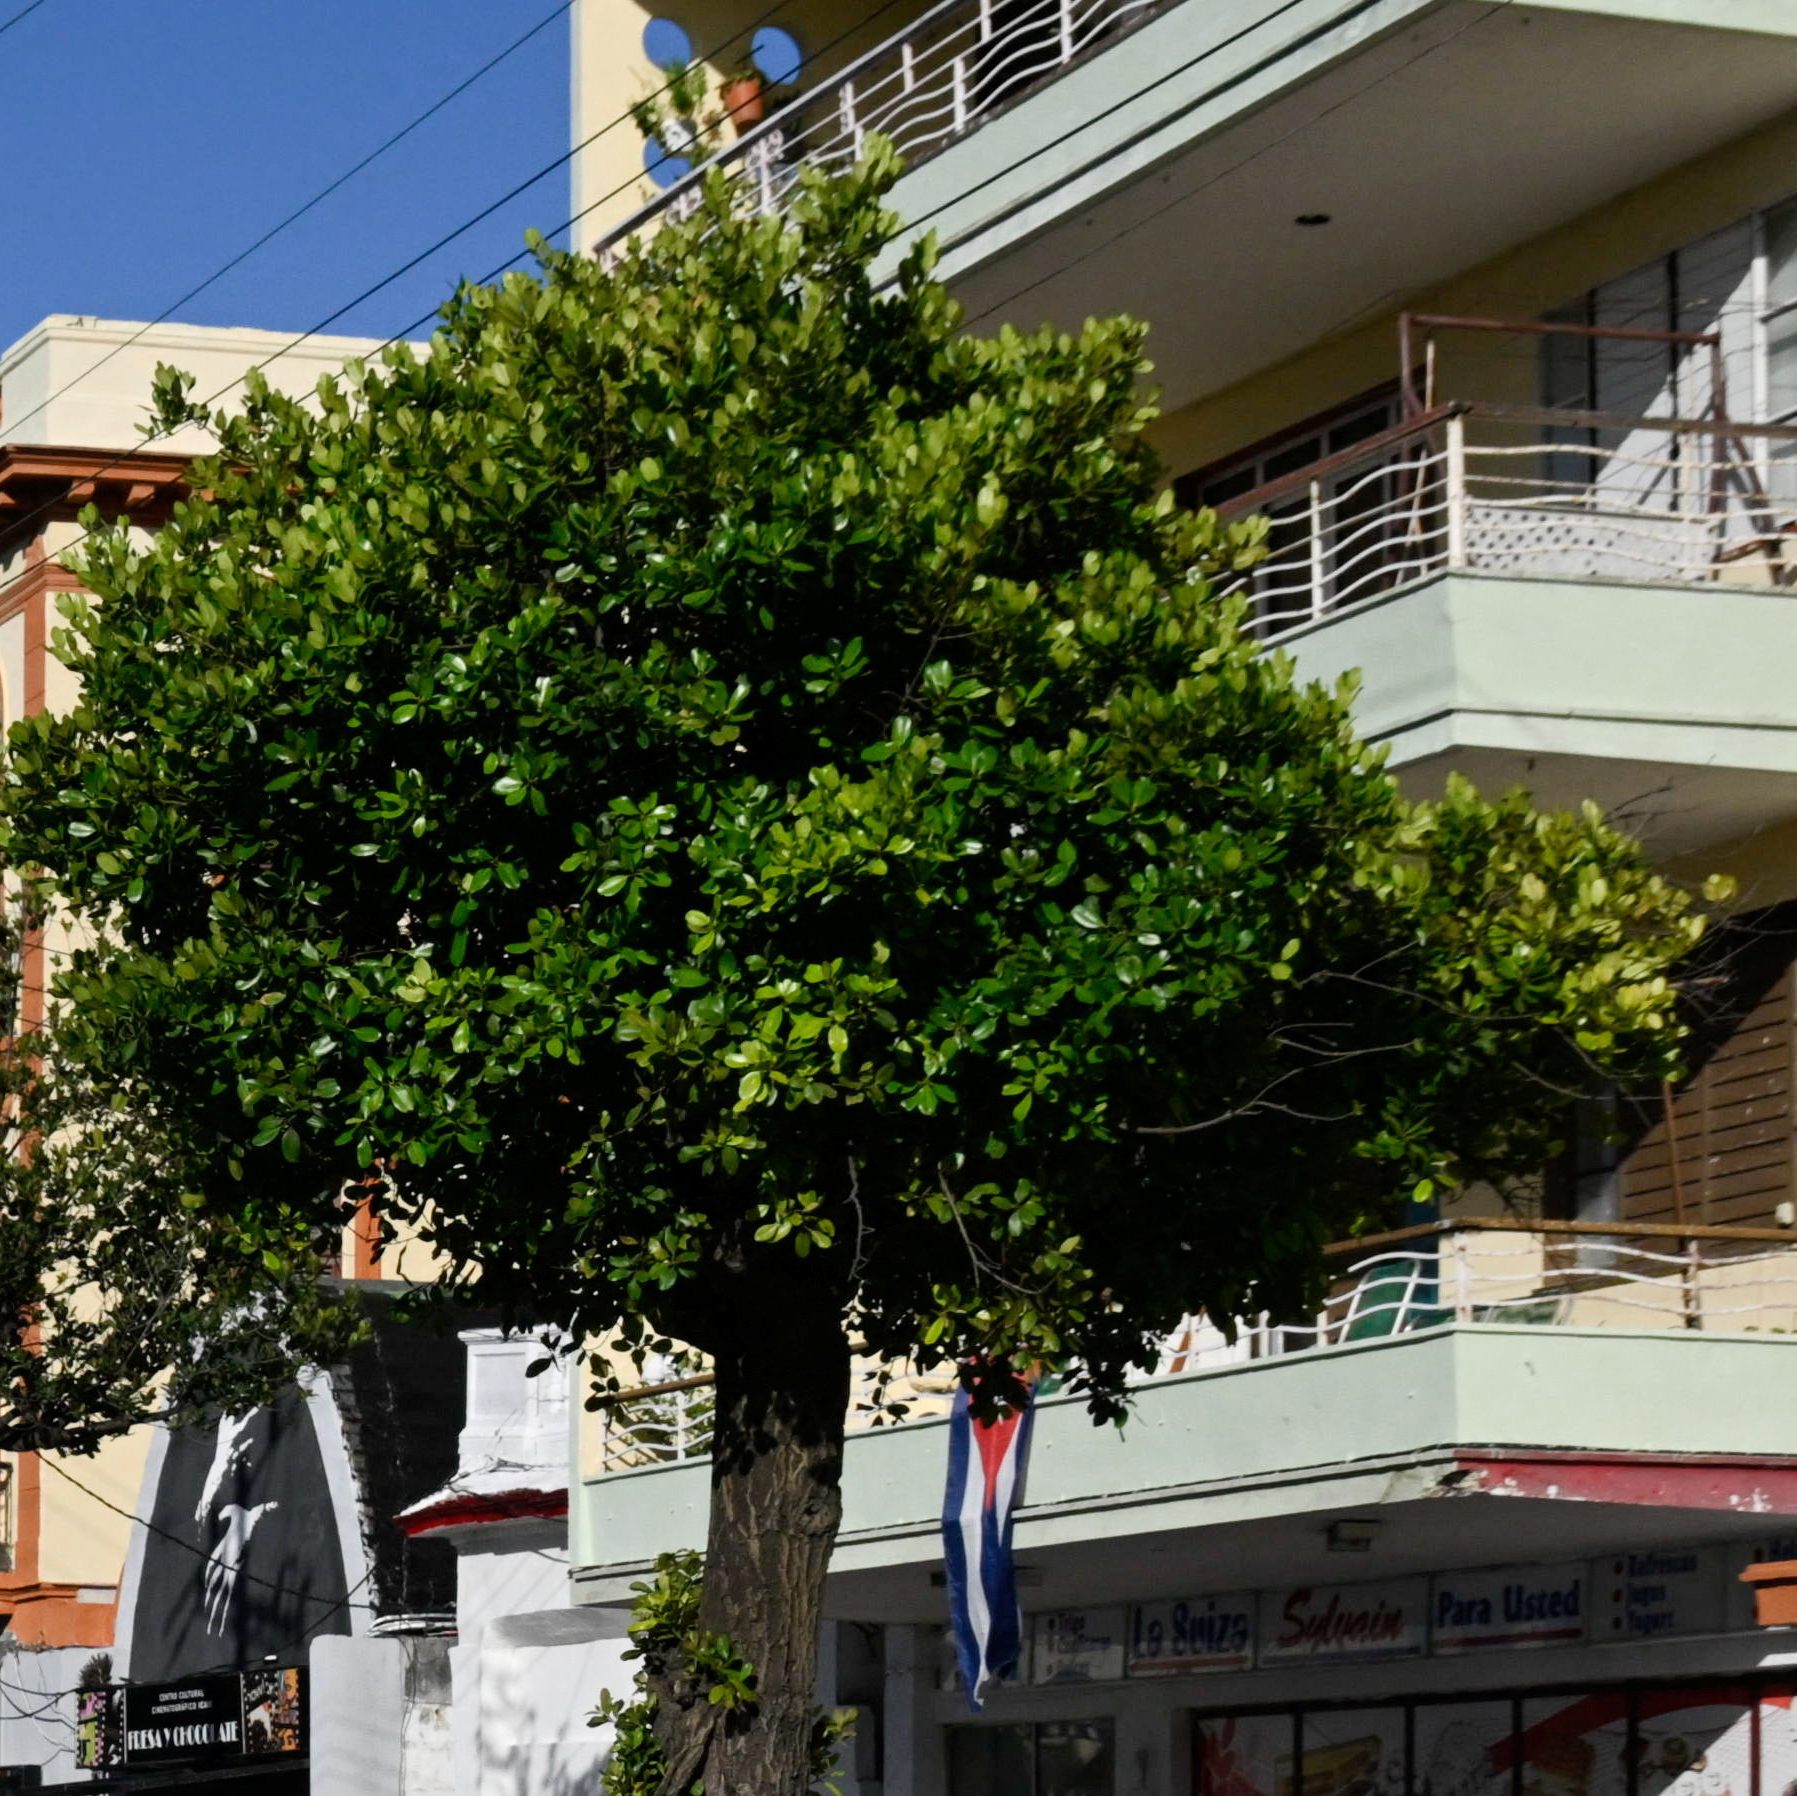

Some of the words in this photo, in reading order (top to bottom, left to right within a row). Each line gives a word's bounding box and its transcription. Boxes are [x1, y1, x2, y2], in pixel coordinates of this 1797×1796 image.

[1172, 1602, 1248, 1656] Suiza
[1277, 1588, 1405, 1656] Sylvain
[1438, 1590, 1492, 1629] Para
[1504, 1579, 1581, 1623] Usted
[128, 1728, 163, 1751] FRESA
[163, 1727, 172, 1748] Y
